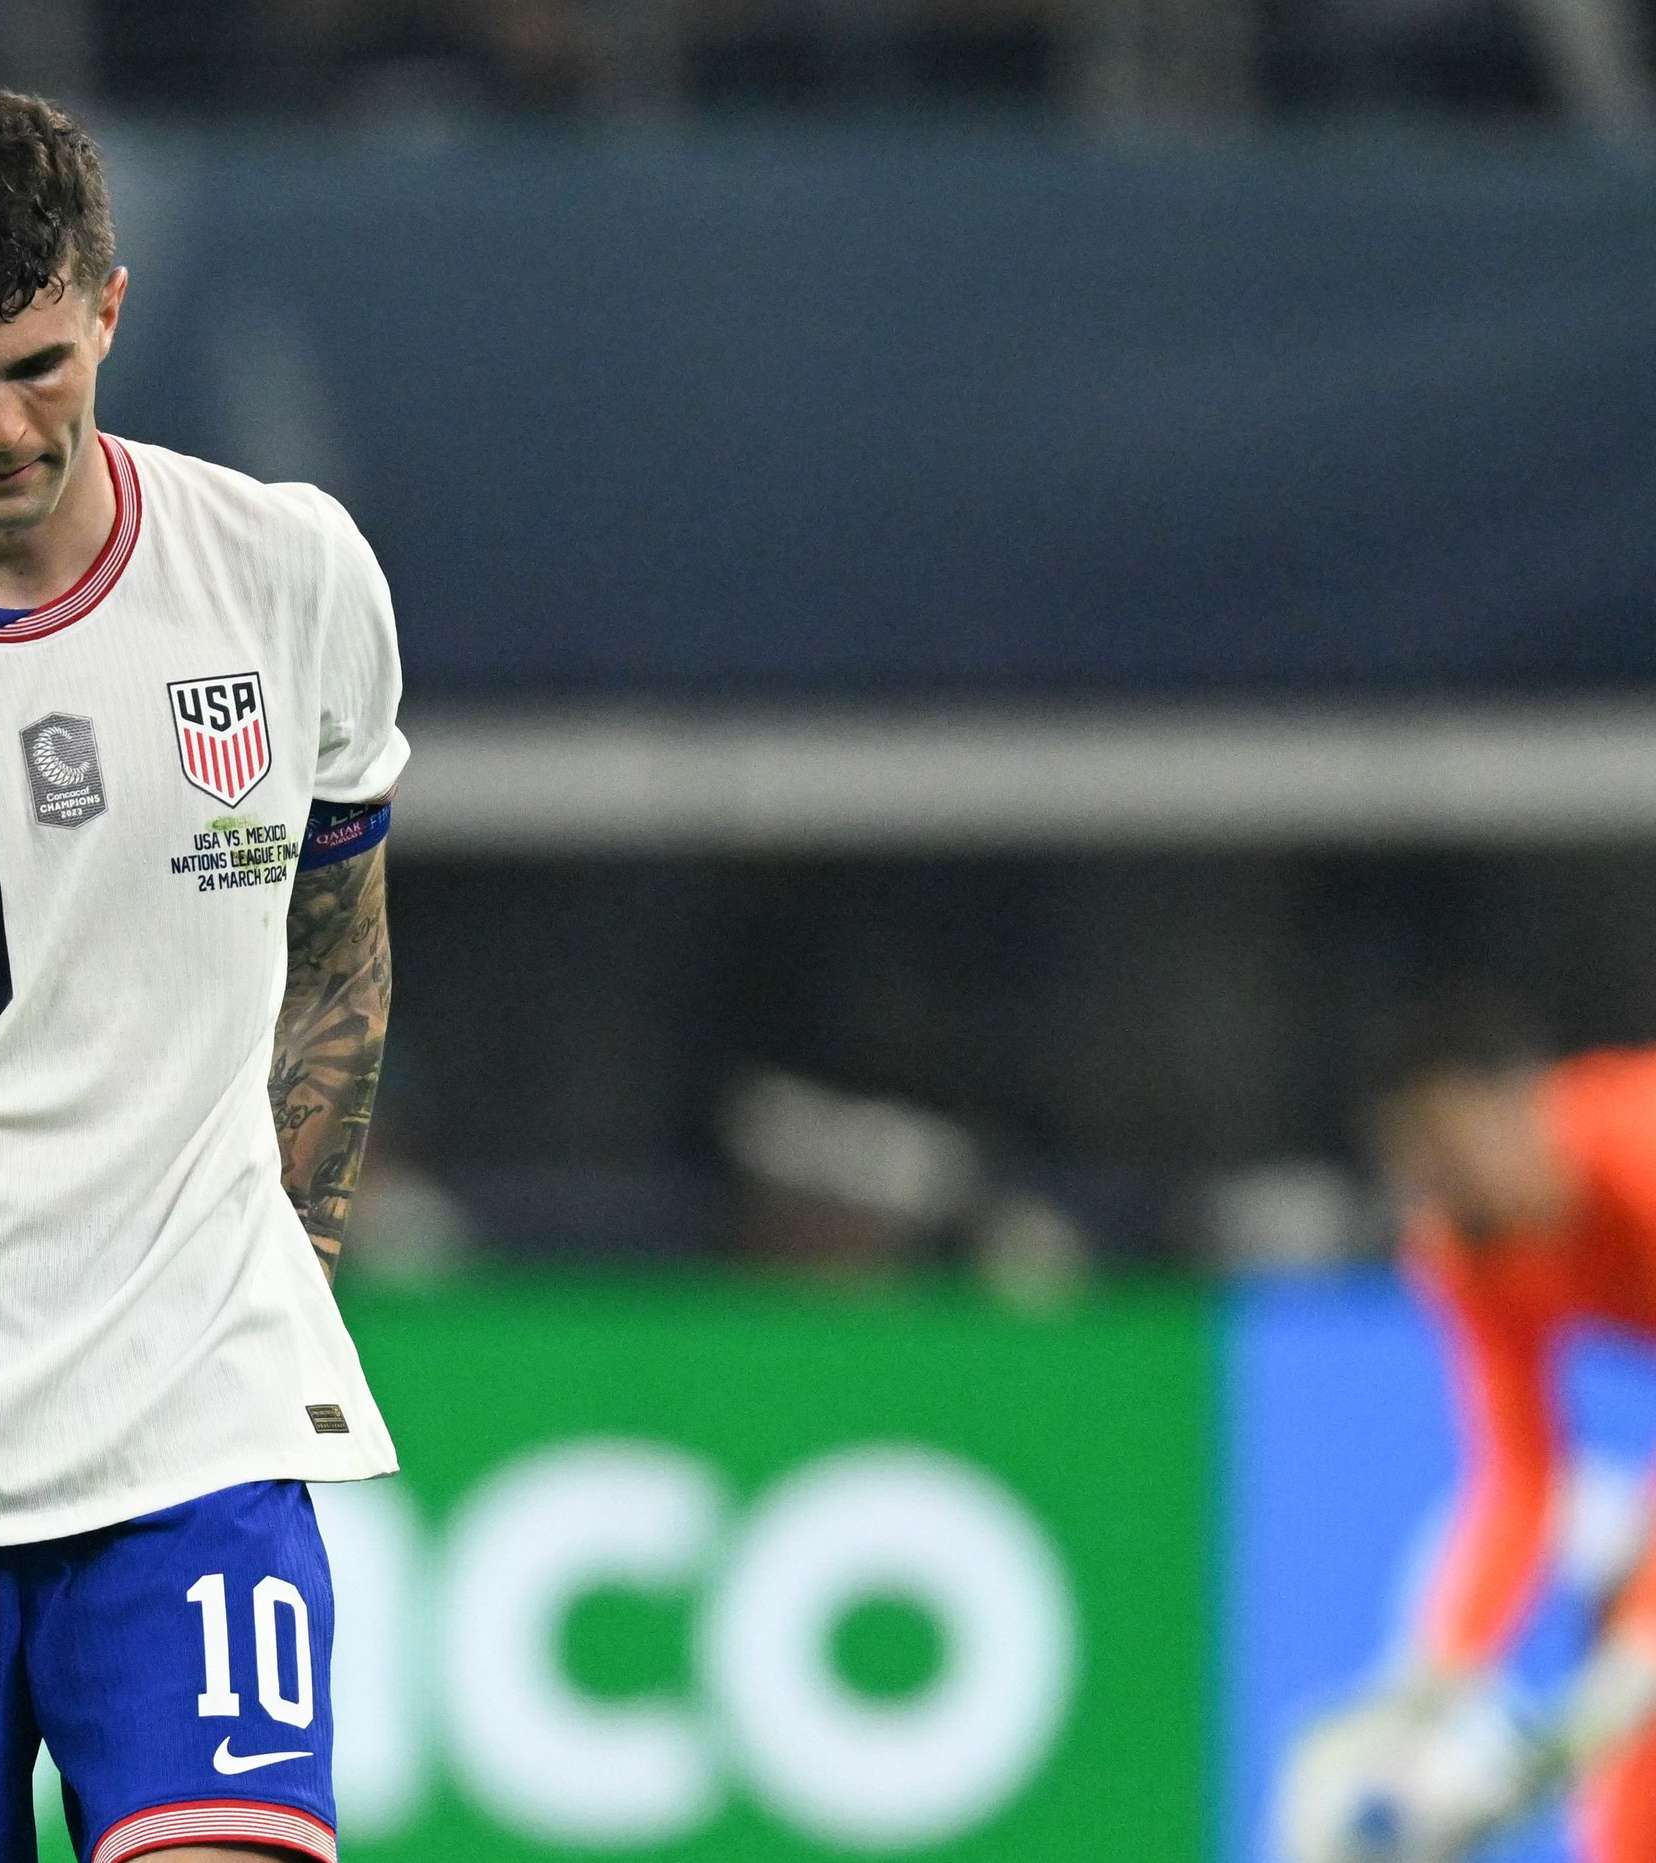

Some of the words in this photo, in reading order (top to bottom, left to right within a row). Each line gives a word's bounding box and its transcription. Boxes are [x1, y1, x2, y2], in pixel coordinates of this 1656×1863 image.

[177, 682, 256, 732] USA
[40, 795, 100, 813] CHAMPIONS
[46, 787, 89, 802] Concacaf
[61, 808, 83, 819] 2023
[194, 832, 221, 851] USA
[224, 830, 244, 847] VS.
[246, 824, 287, 845] MEXICO
[171, 852, 227, 874] NATIONS
[230, 846, 275, 868] LEAGUE
[277, 842, 299, 862] FINAL
[198, 874, 216, 892] 24
[218, 868, 262, 890] MARCH
[264, 864, 287, 884] 2024
[186, 1573, 314, 1730] 10
